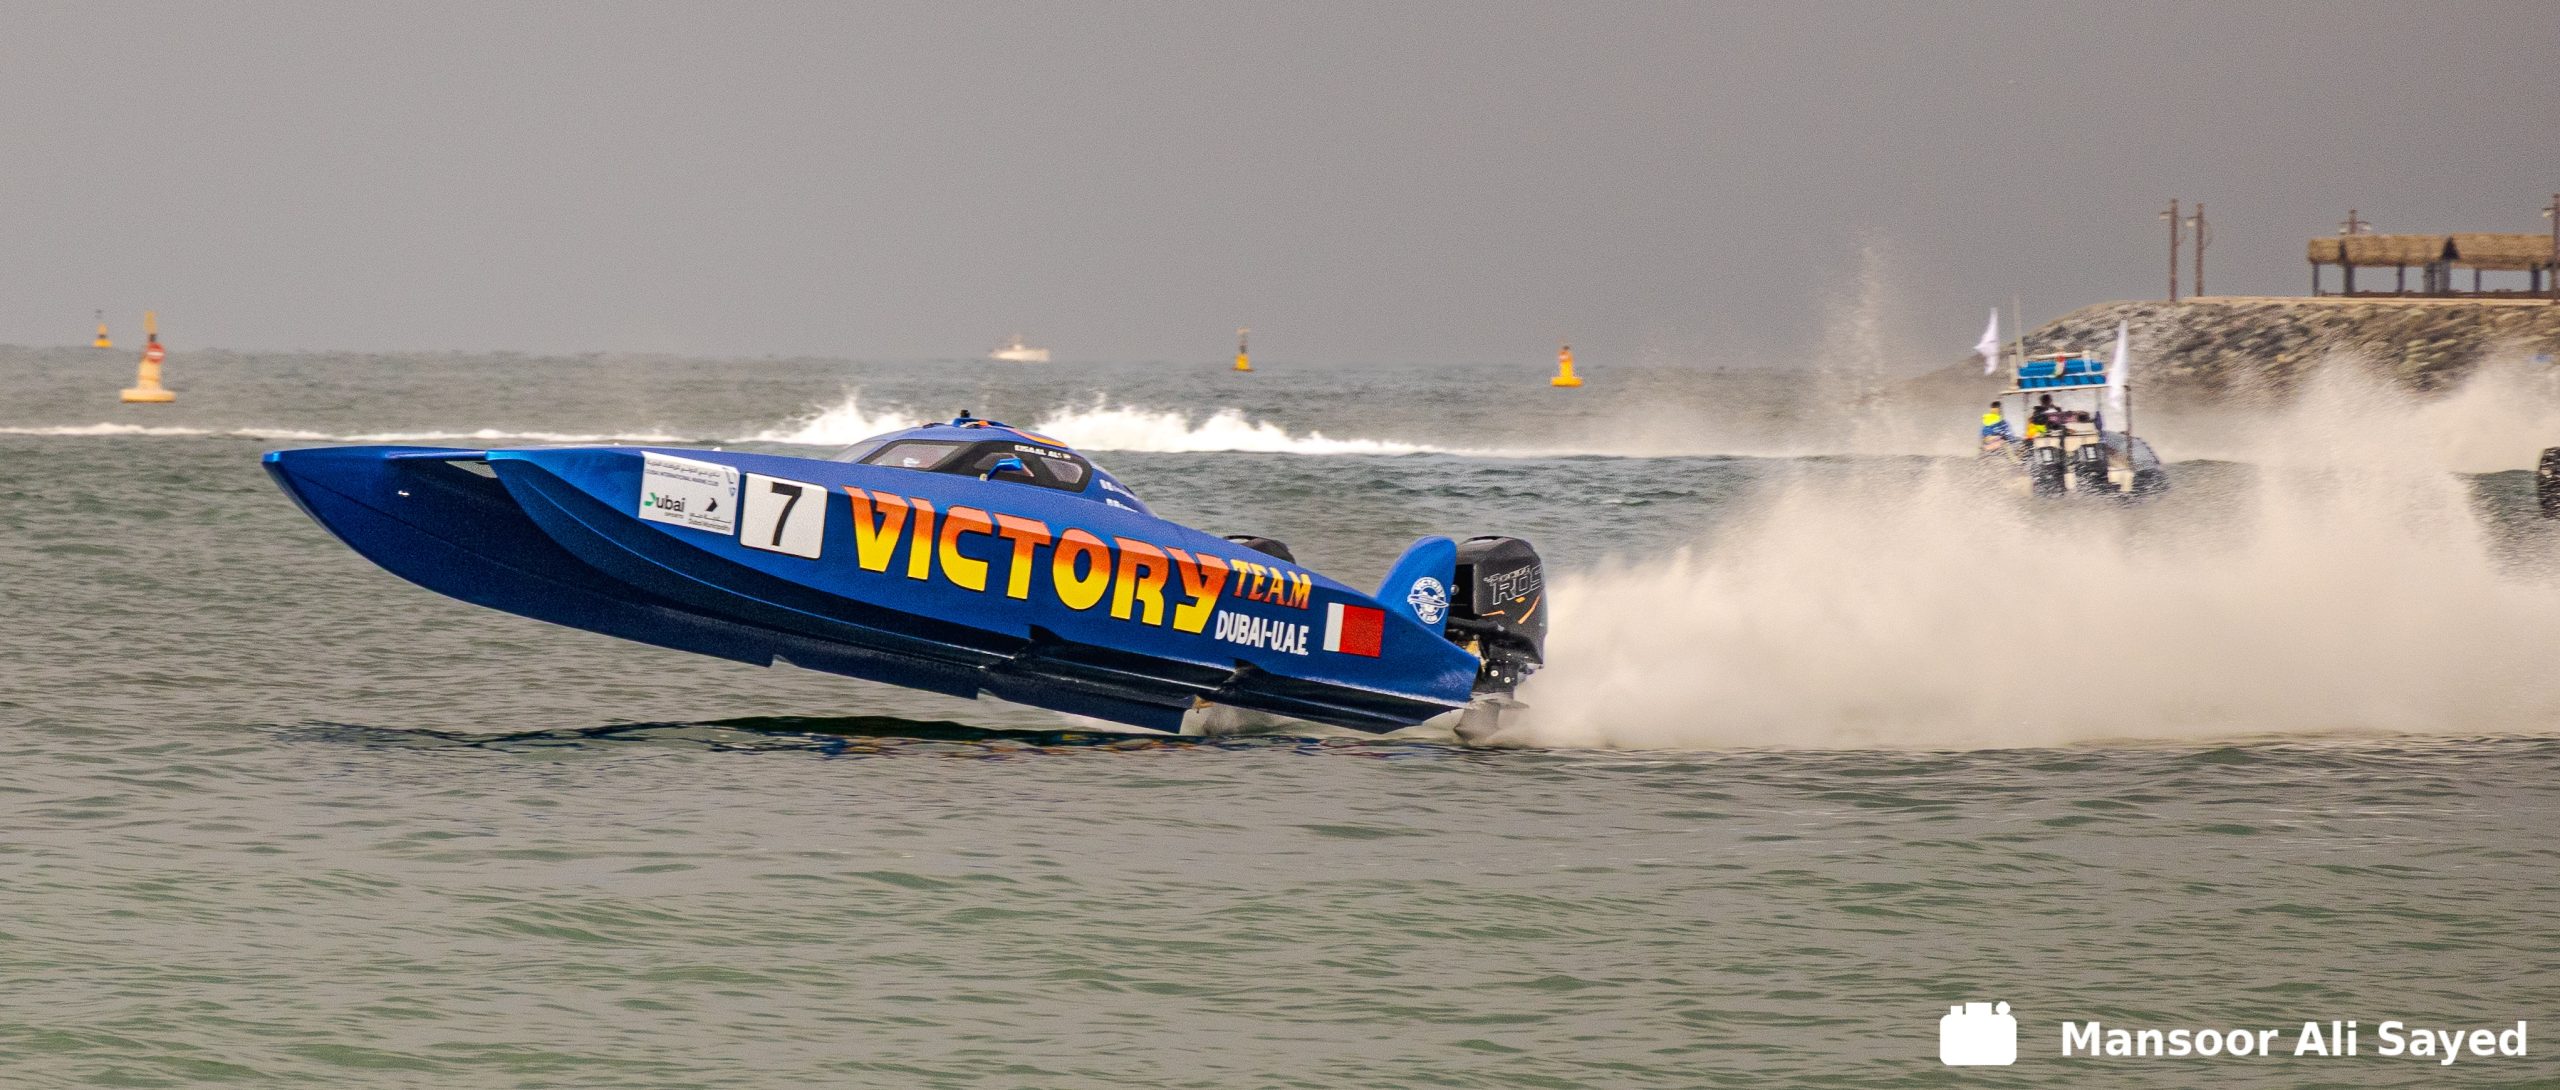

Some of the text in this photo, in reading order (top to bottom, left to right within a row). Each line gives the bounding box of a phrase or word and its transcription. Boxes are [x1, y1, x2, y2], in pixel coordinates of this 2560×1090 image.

[771, 481, 803, 546] 7
[841, 485, 1230, 634] VICTORY
[1229, 559, 1313, 610] TEAM
